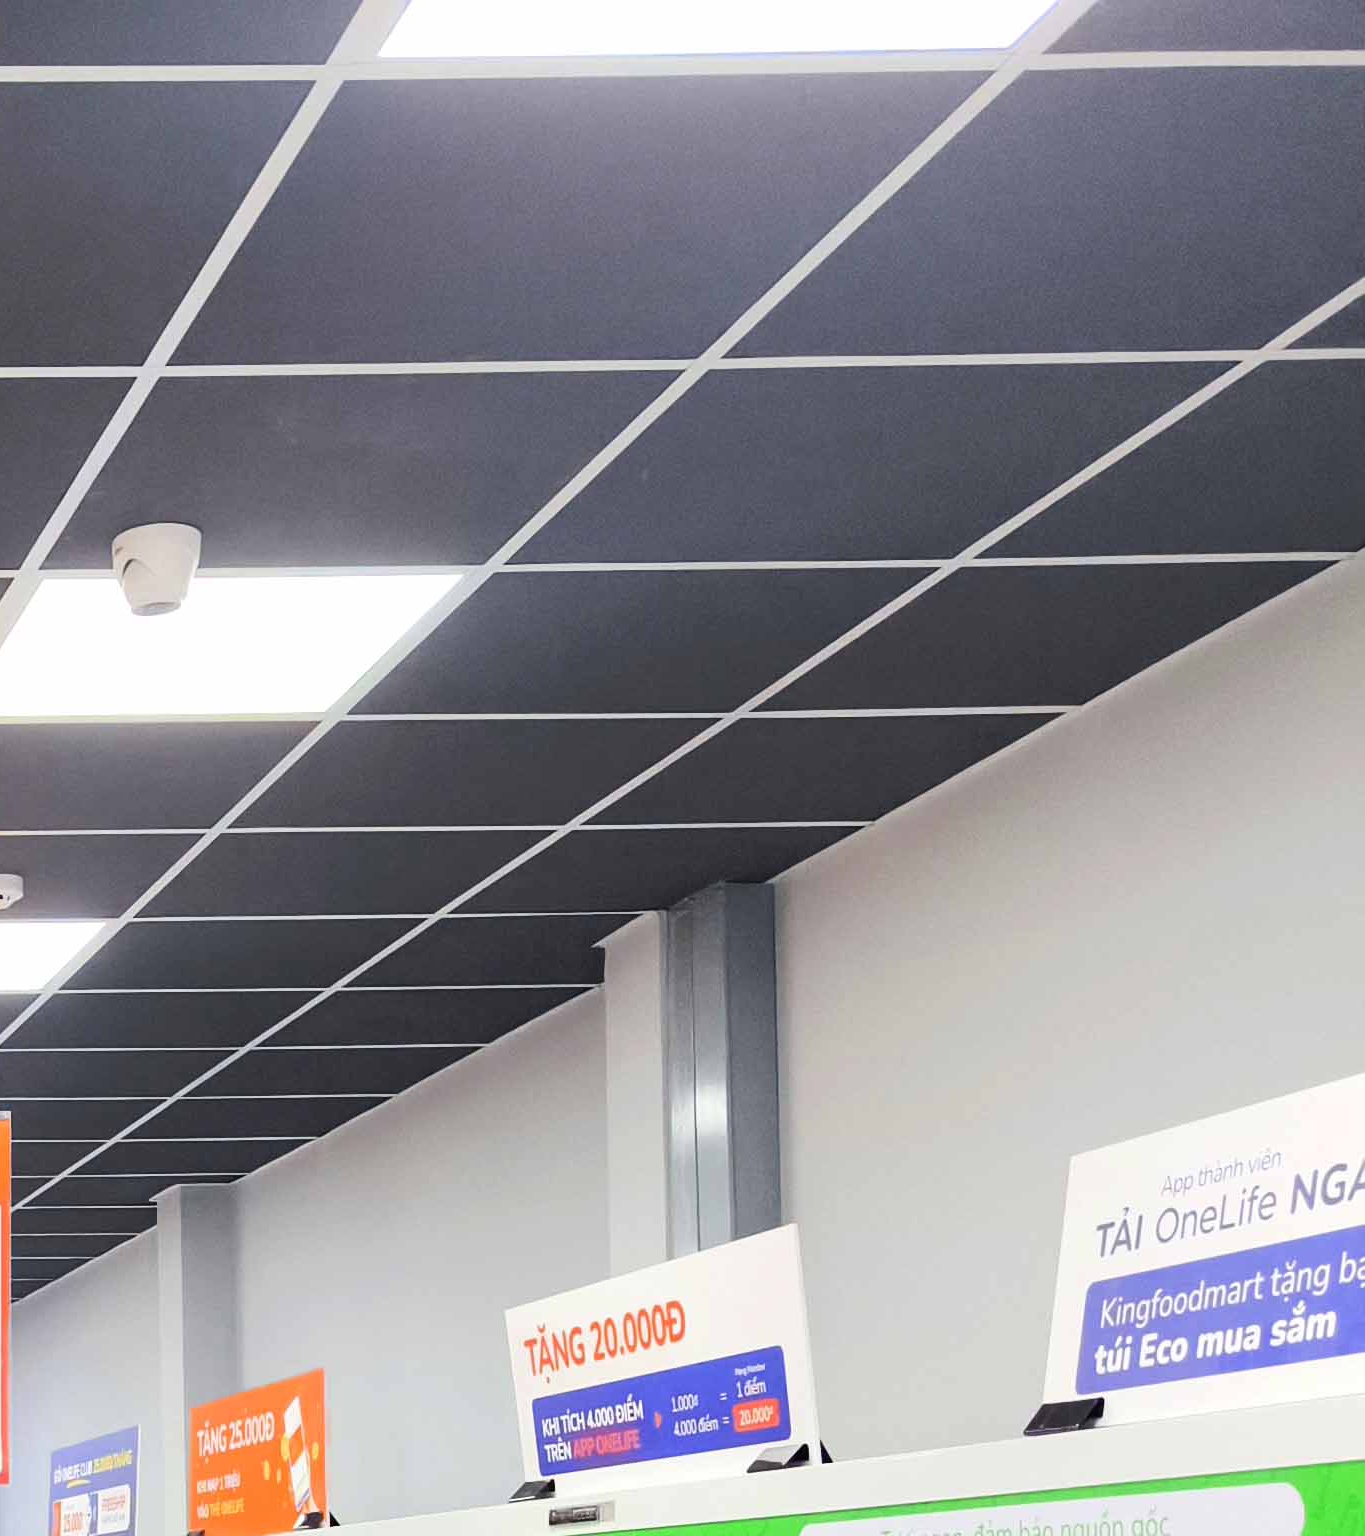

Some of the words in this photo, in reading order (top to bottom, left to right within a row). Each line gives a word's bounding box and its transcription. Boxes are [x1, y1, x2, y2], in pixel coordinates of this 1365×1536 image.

[1161, 1175, 1193, 1197] App
[1196, 1158, 1244, 1189] thành
[1096, 1207, 1143, 1258] TẢI
[1155, 1185, 1277, 1243] OneLife
[1100, 1272, 1264, 1329] Kingfoodmart
[1271, 1260, 1331, 1302] tặng
[524, 1324, 585, 1383] TẶNG
[590, 1300, 686, 1361] 20.000Đ
[1094, 1332, 1132, 1376] túi
[1139, 1334, 1188, 1369] Eco
[1196, 1324, 1261, 1359] mua
[1270, 1301, 1338, 1348] sắm
